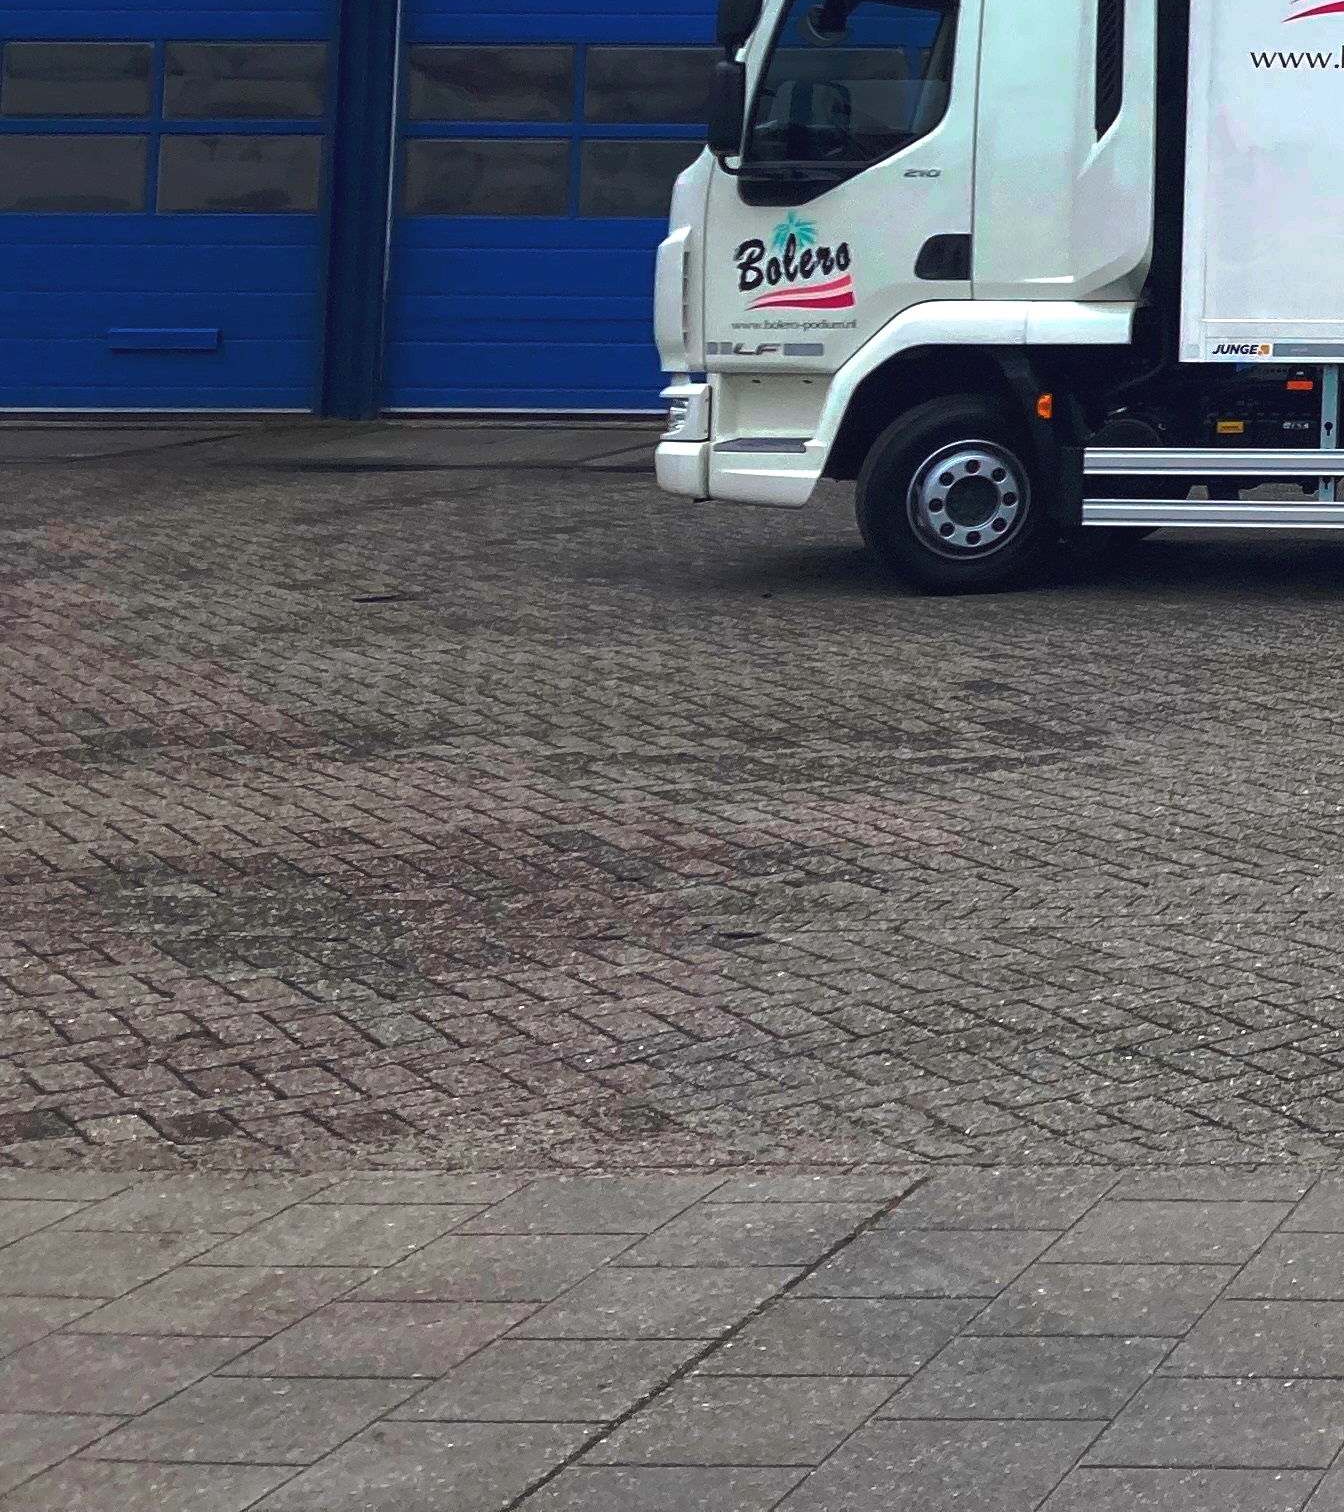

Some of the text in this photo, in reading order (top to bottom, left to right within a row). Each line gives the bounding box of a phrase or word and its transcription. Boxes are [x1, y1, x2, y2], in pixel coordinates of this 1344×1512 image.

[732, 233, 852, 293] Bolero
[731, 319, 858, 331] www.bolero-podium.nl
[732, 342, 782, 356] LF
[1212, 344, 1260, 355] JUNGE
